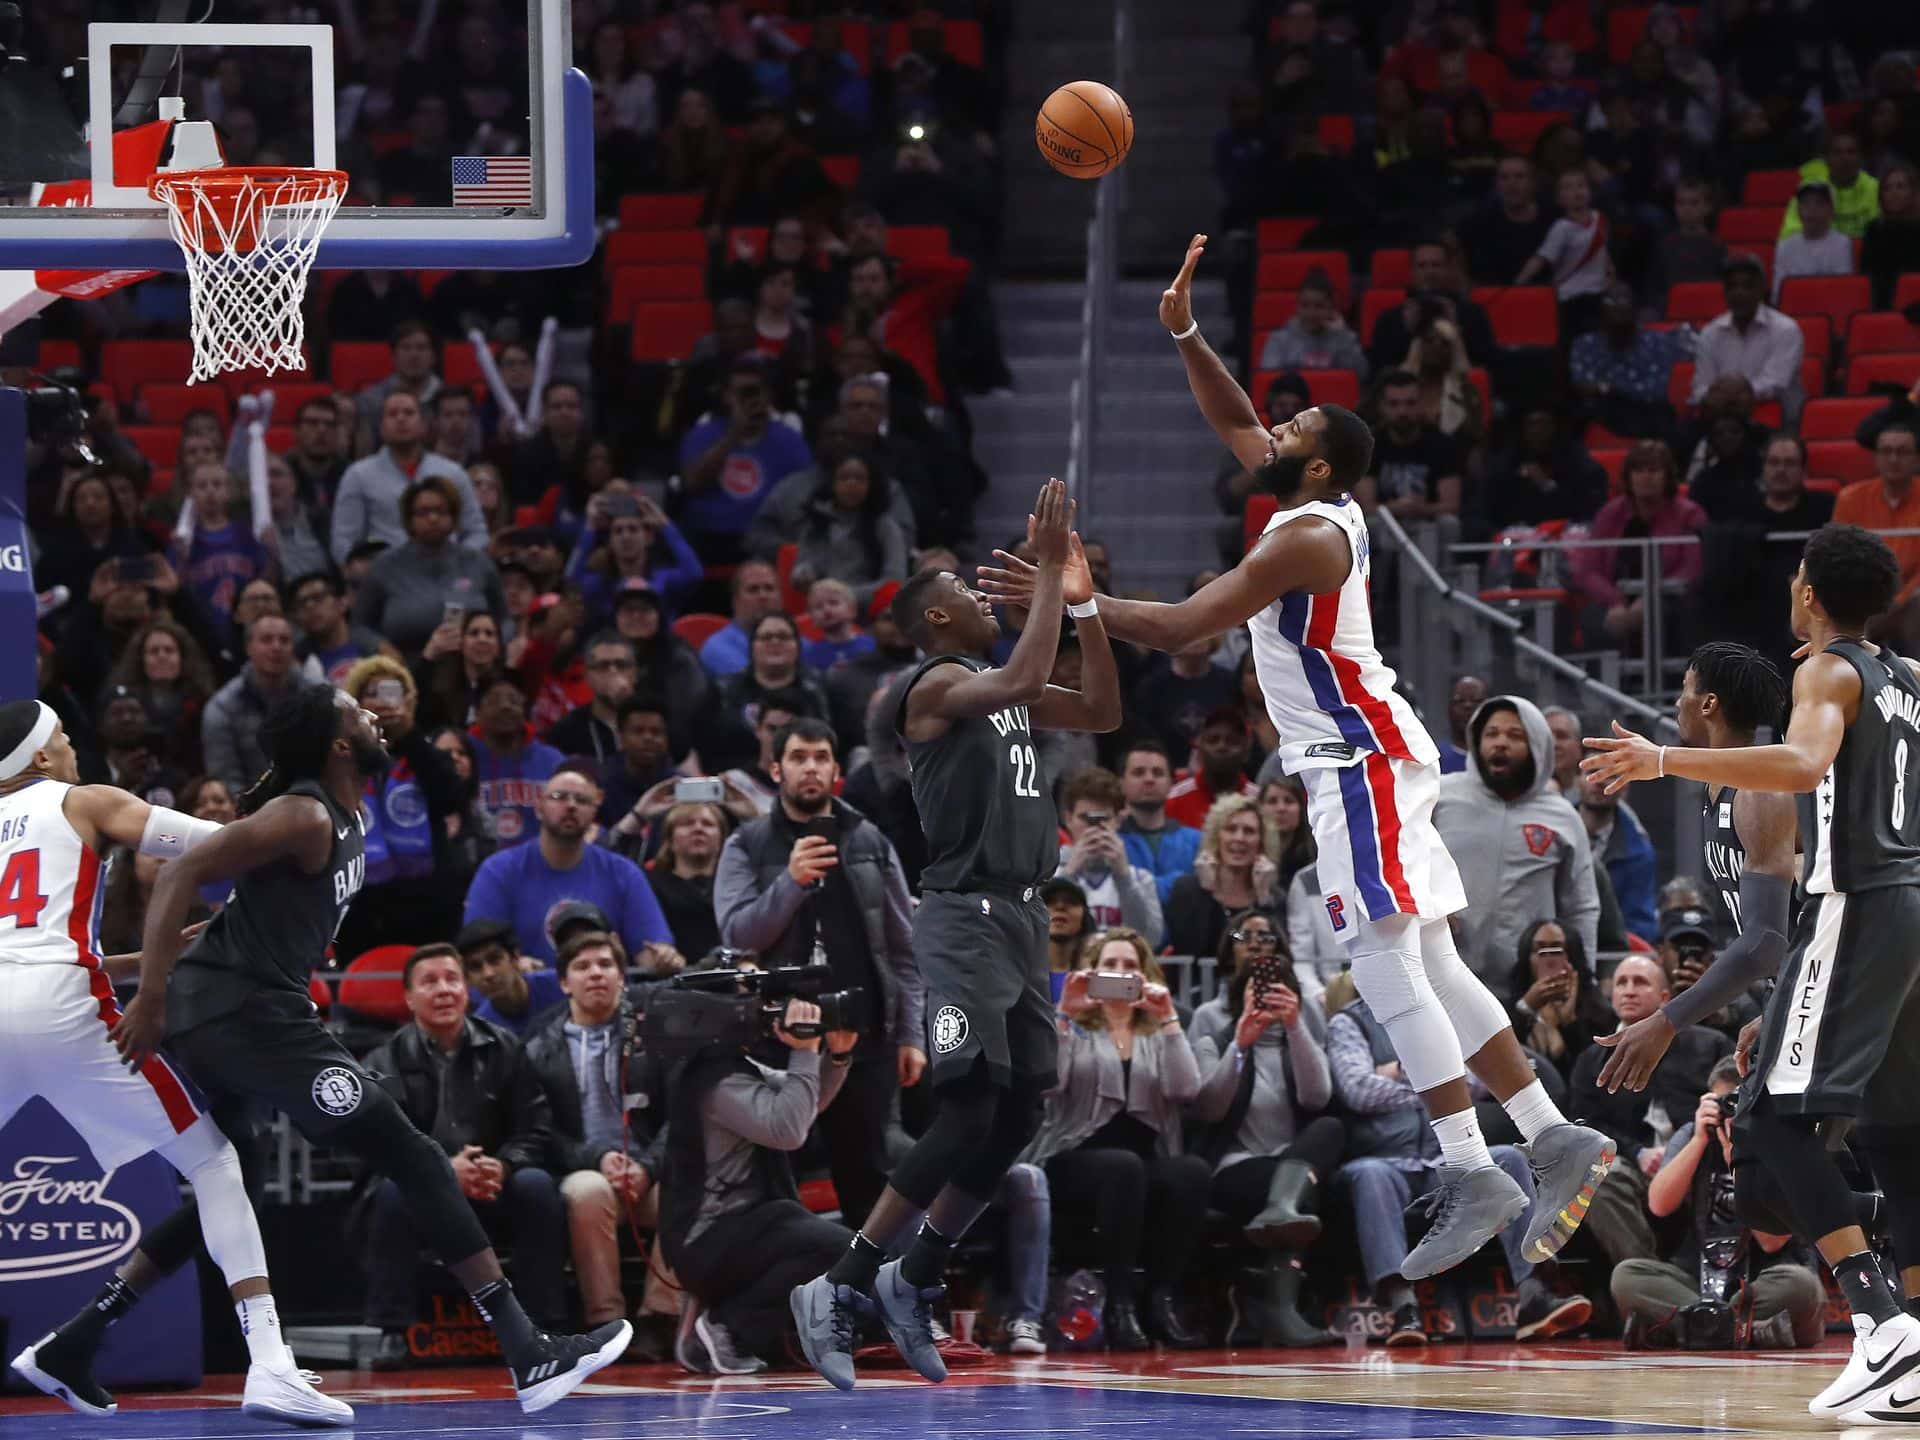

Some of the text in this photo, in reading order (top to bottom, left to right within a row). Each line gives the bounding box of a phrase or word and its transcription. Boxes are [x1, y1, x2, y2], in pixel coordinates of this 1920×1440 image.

[1036, 127, 1081, 163] PALDING
[1010, 744, 1040, 797] 22
[1891, 738, 1909, 831] 8
[0, 847, 49, 928] 4
[1790, 959, 1821, 1066] NETS
[0, 1156, 117, 1215] Ford
[0, 1221, 125, 1241] YSTEM
[1326, 1303, 1457, 1337] Caesrs
